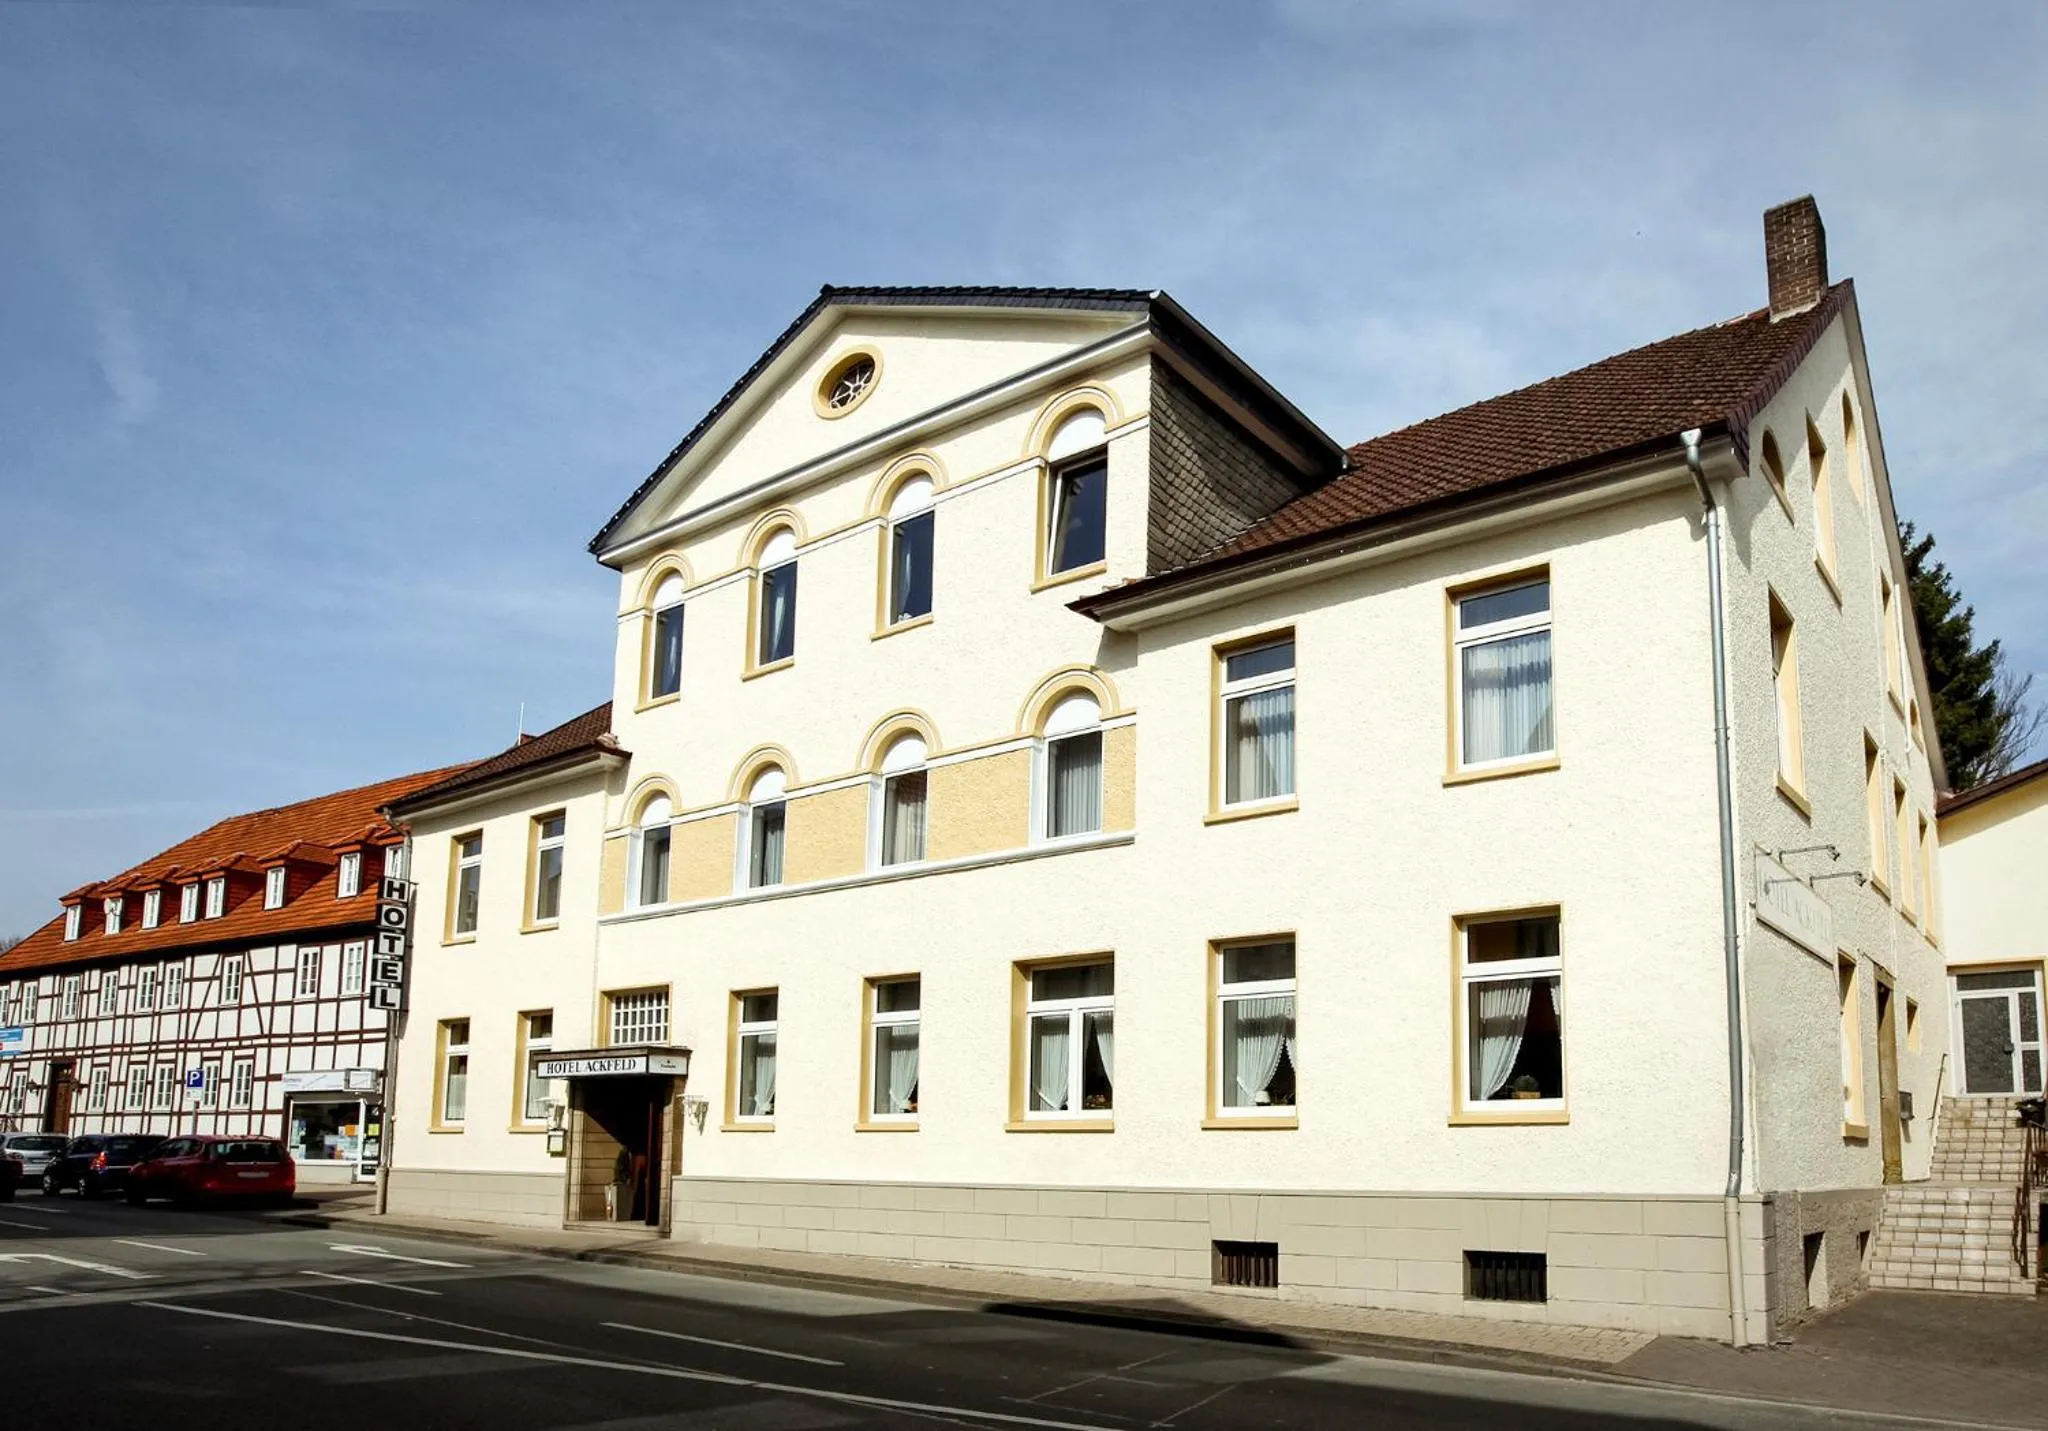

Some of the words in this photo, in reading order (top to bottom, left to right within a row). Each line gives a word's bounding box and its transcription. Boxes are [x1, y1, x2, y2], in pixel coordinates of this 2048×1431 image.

[381, 880, 406, 1007] HOTEL
[546, 1062, 580, 1074] HOTEL
[585, 1059, 637, 1073] ACKFELD
[189, 1071, 200, 1085] P
